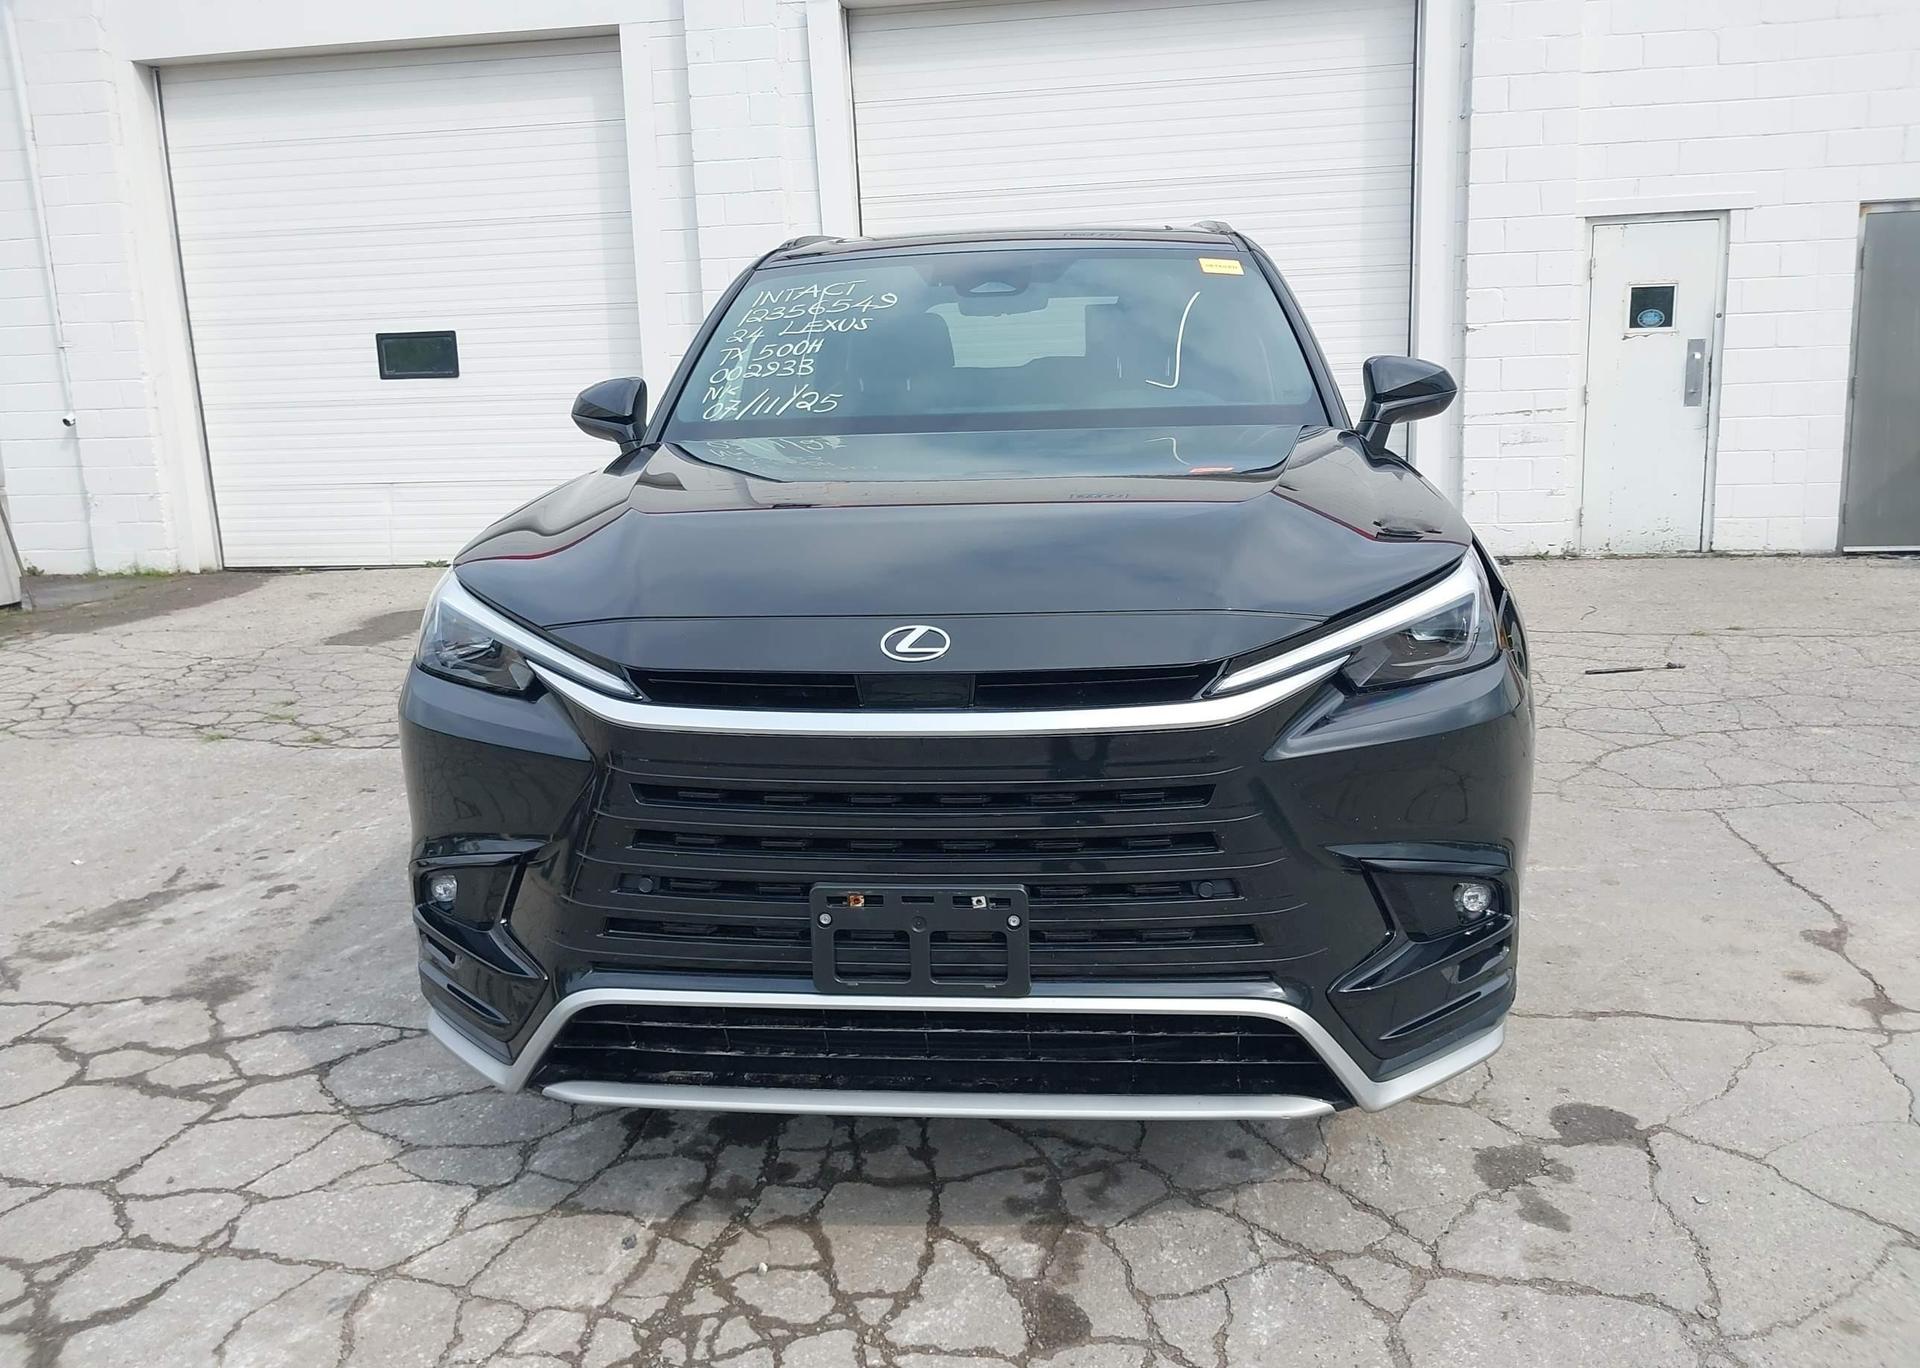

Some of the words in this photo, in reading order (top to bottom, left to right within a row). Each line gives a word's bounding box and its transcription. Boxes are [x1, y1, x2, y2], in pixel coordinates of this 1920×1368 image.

[752, 280, 867, 307] INTACT
[726, 326, 765, 343] 24
[778, 317, 874, 336] LEXUS
[719, 347, 748, 366] TX
[752, 338, 824, 361] 500H
